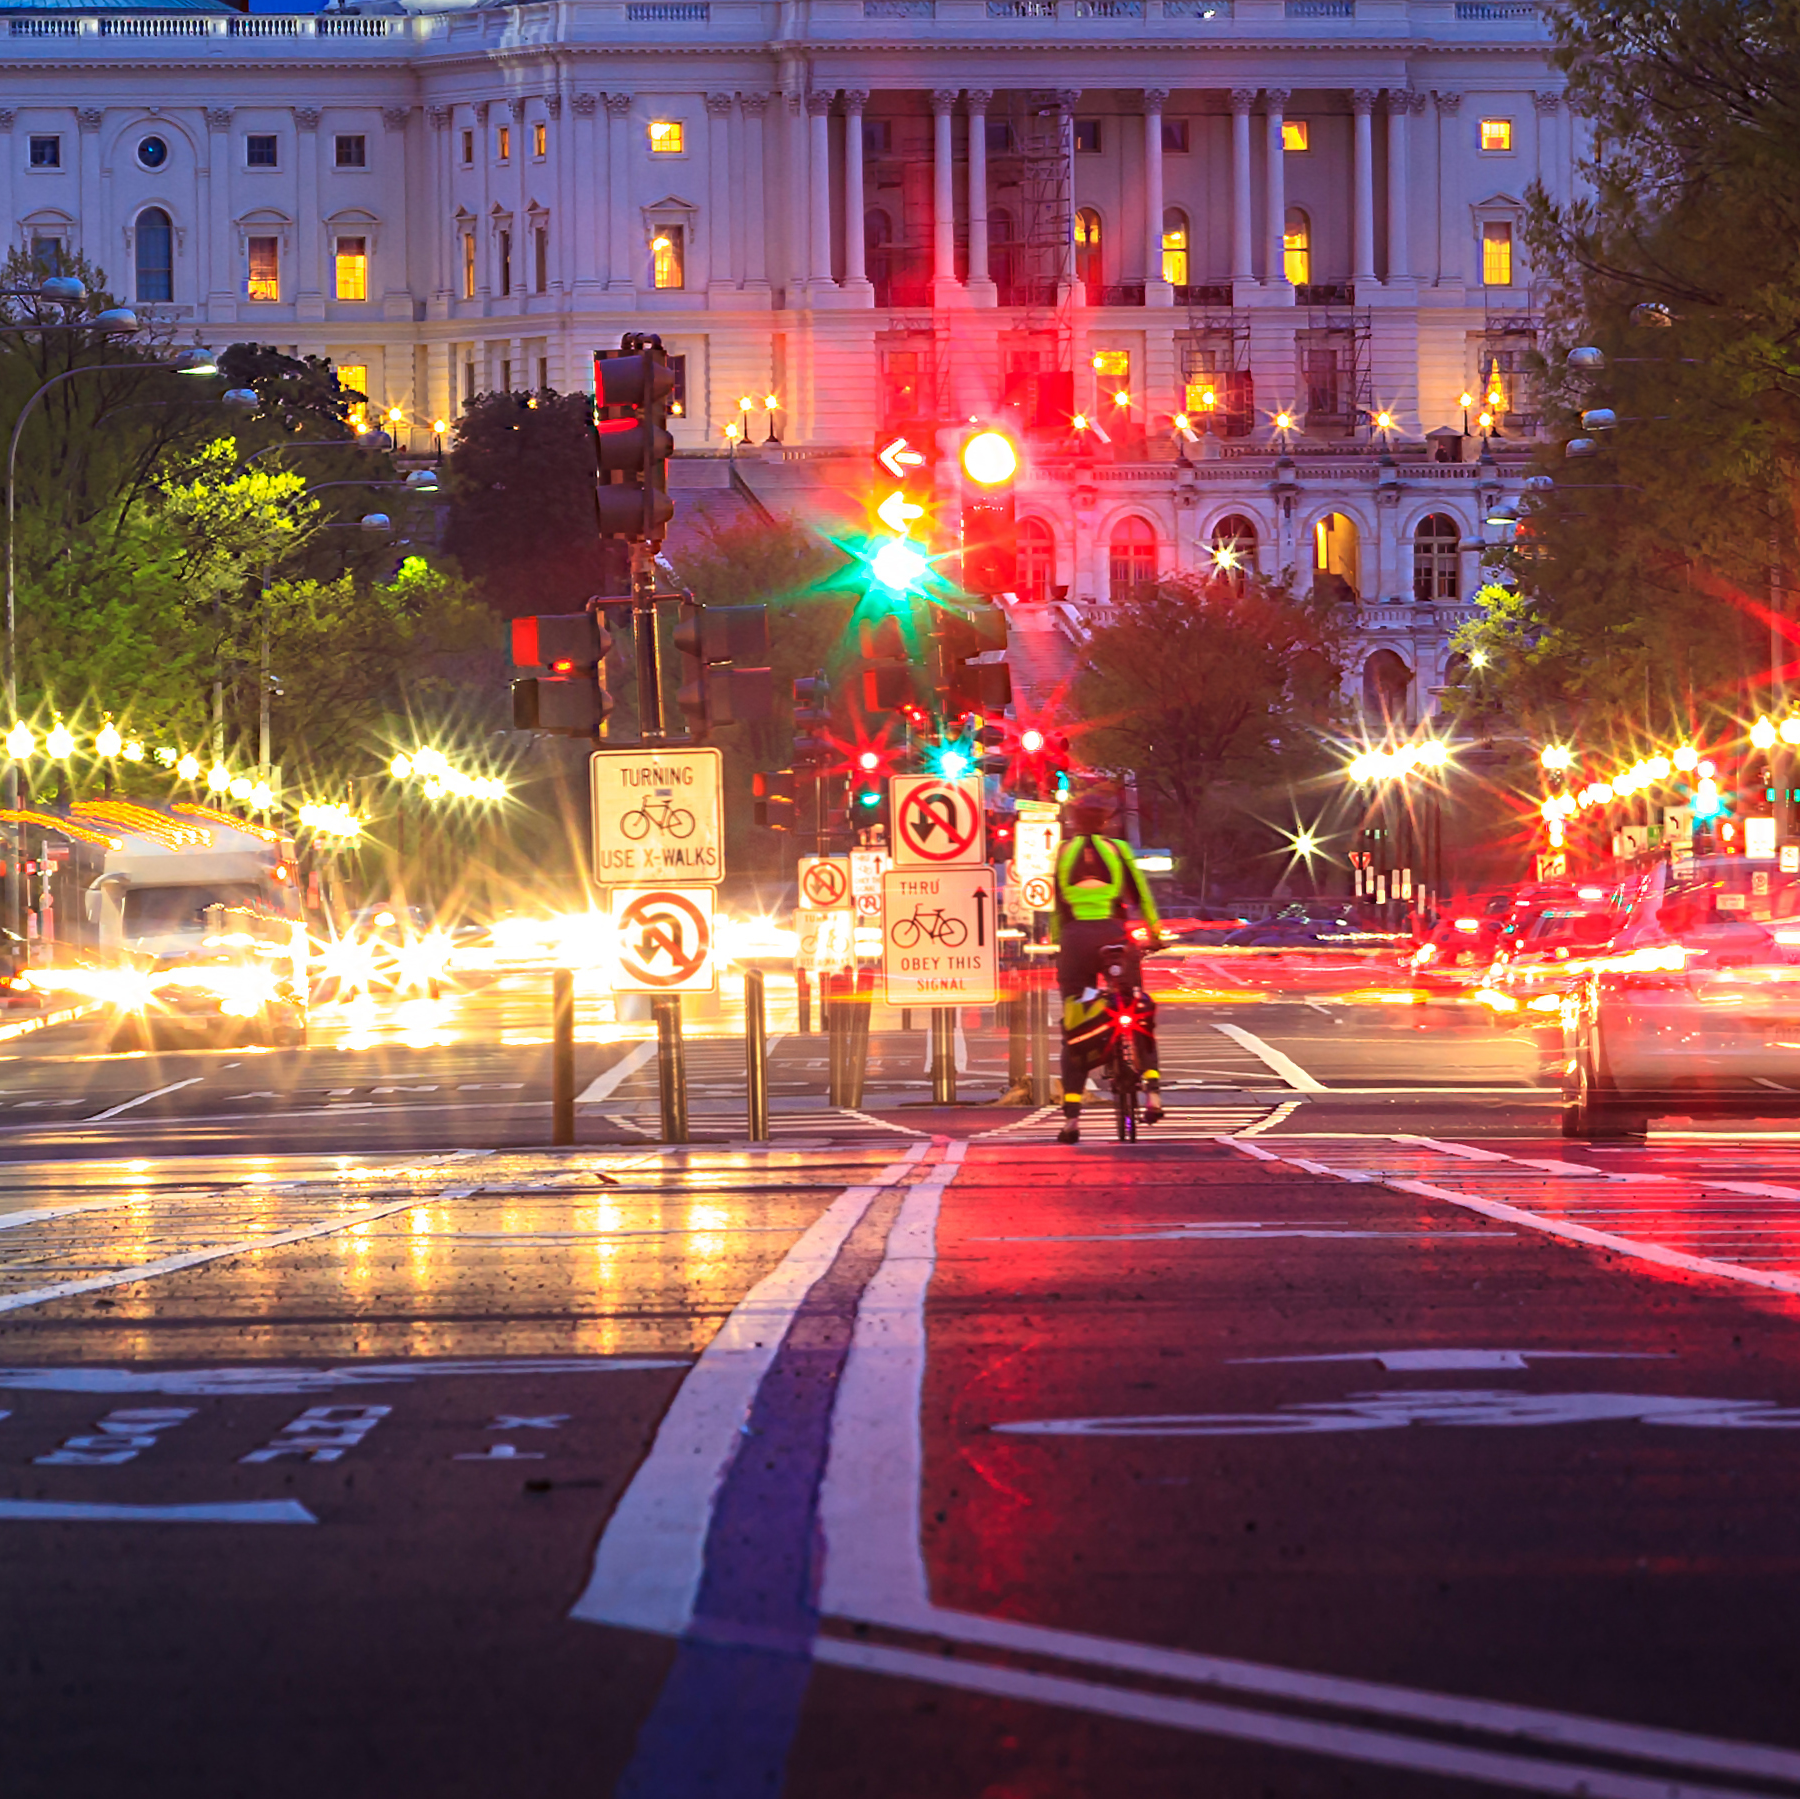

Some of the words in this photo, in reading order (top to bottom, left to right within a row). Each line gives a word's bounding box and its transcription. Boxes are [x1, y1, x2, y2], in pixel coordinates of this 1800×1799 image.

[620, 766, 694, 787] TURNING
[601, 849, 635, 869] USE
[643, 847, 717, 868] X-WALKS
[900, 881, 940, 895] THRU
[901, 957, 941, 971] OBEY
[947, 956, 981, 970] THIS
[917, 978, 967, 992] SIGNAL
